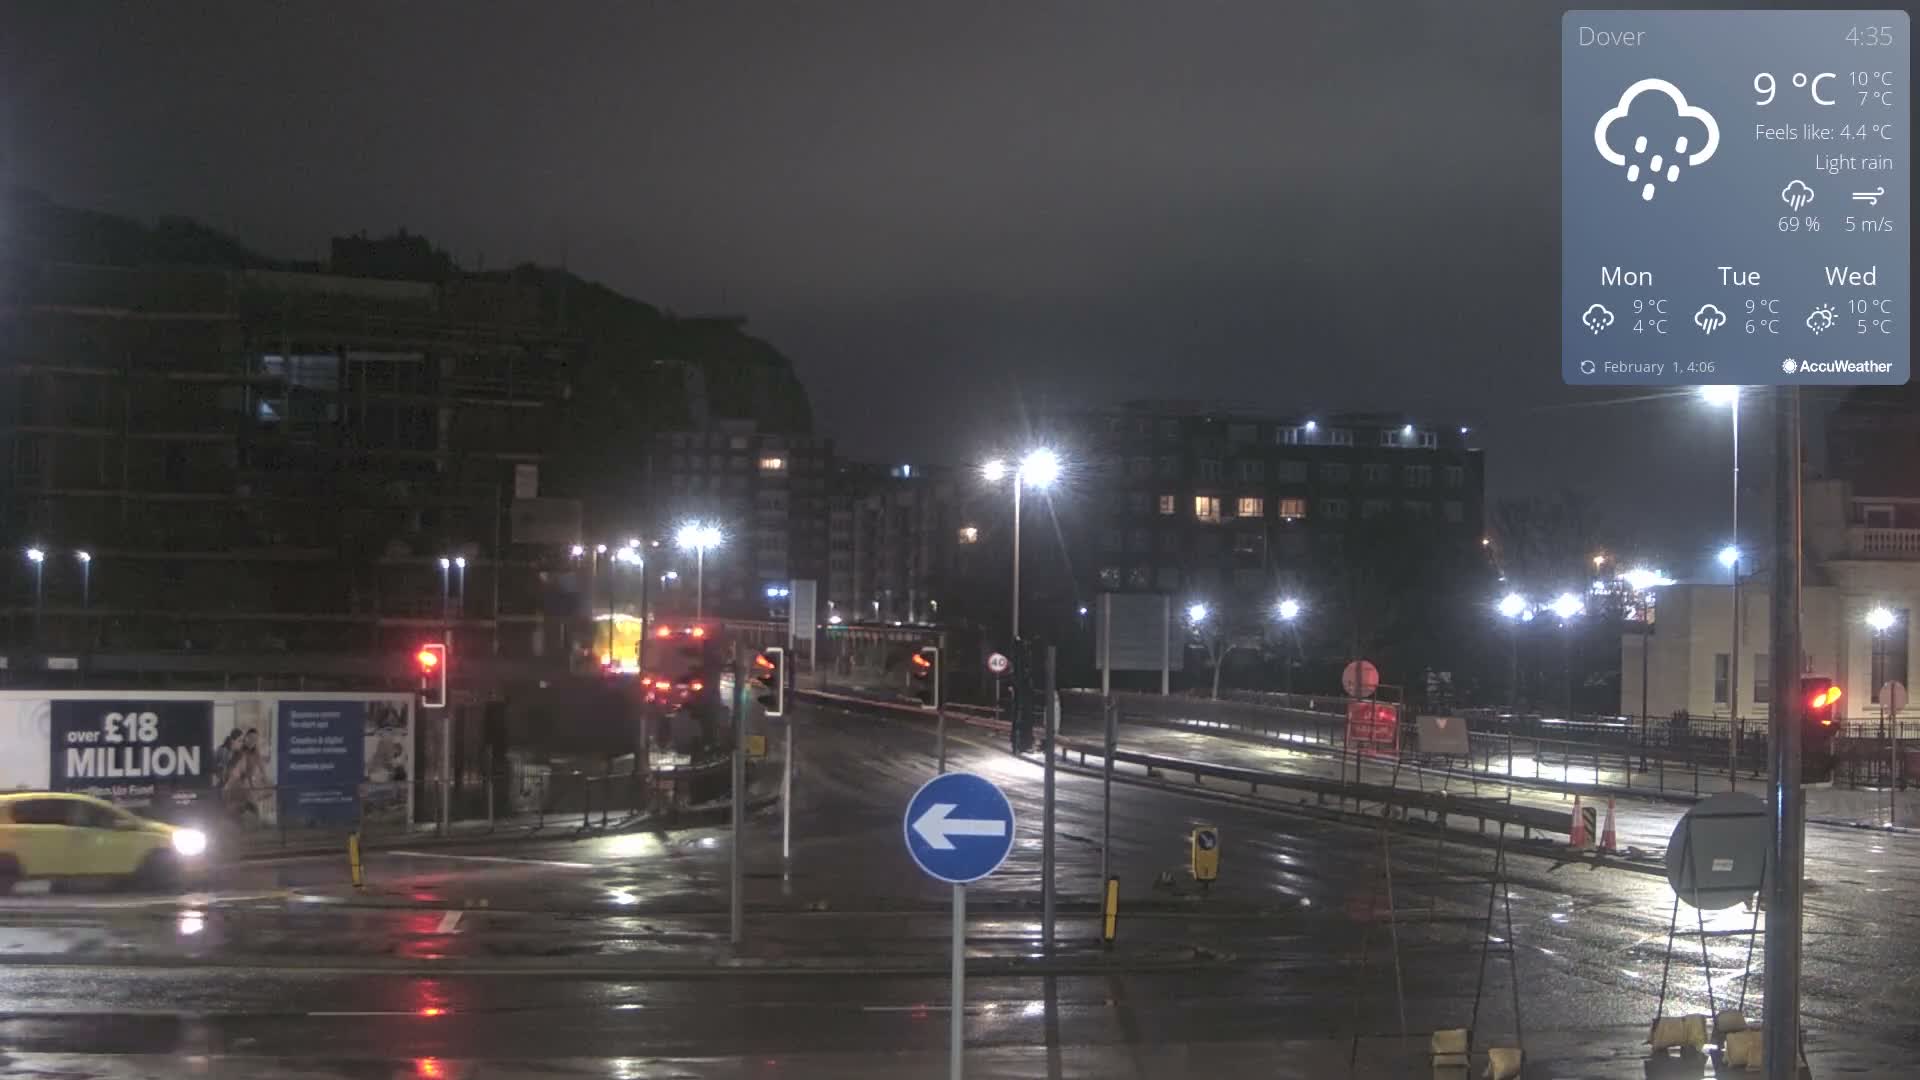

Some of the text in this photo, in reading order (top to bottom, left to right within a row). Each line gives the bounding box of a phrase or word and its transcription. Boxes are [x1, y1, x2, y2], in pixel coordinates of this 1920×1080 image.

[991, 657, 1006, 667] 40
[67, 712, 159, 743] over £18
[66, 746, 201, 778] MILLION
